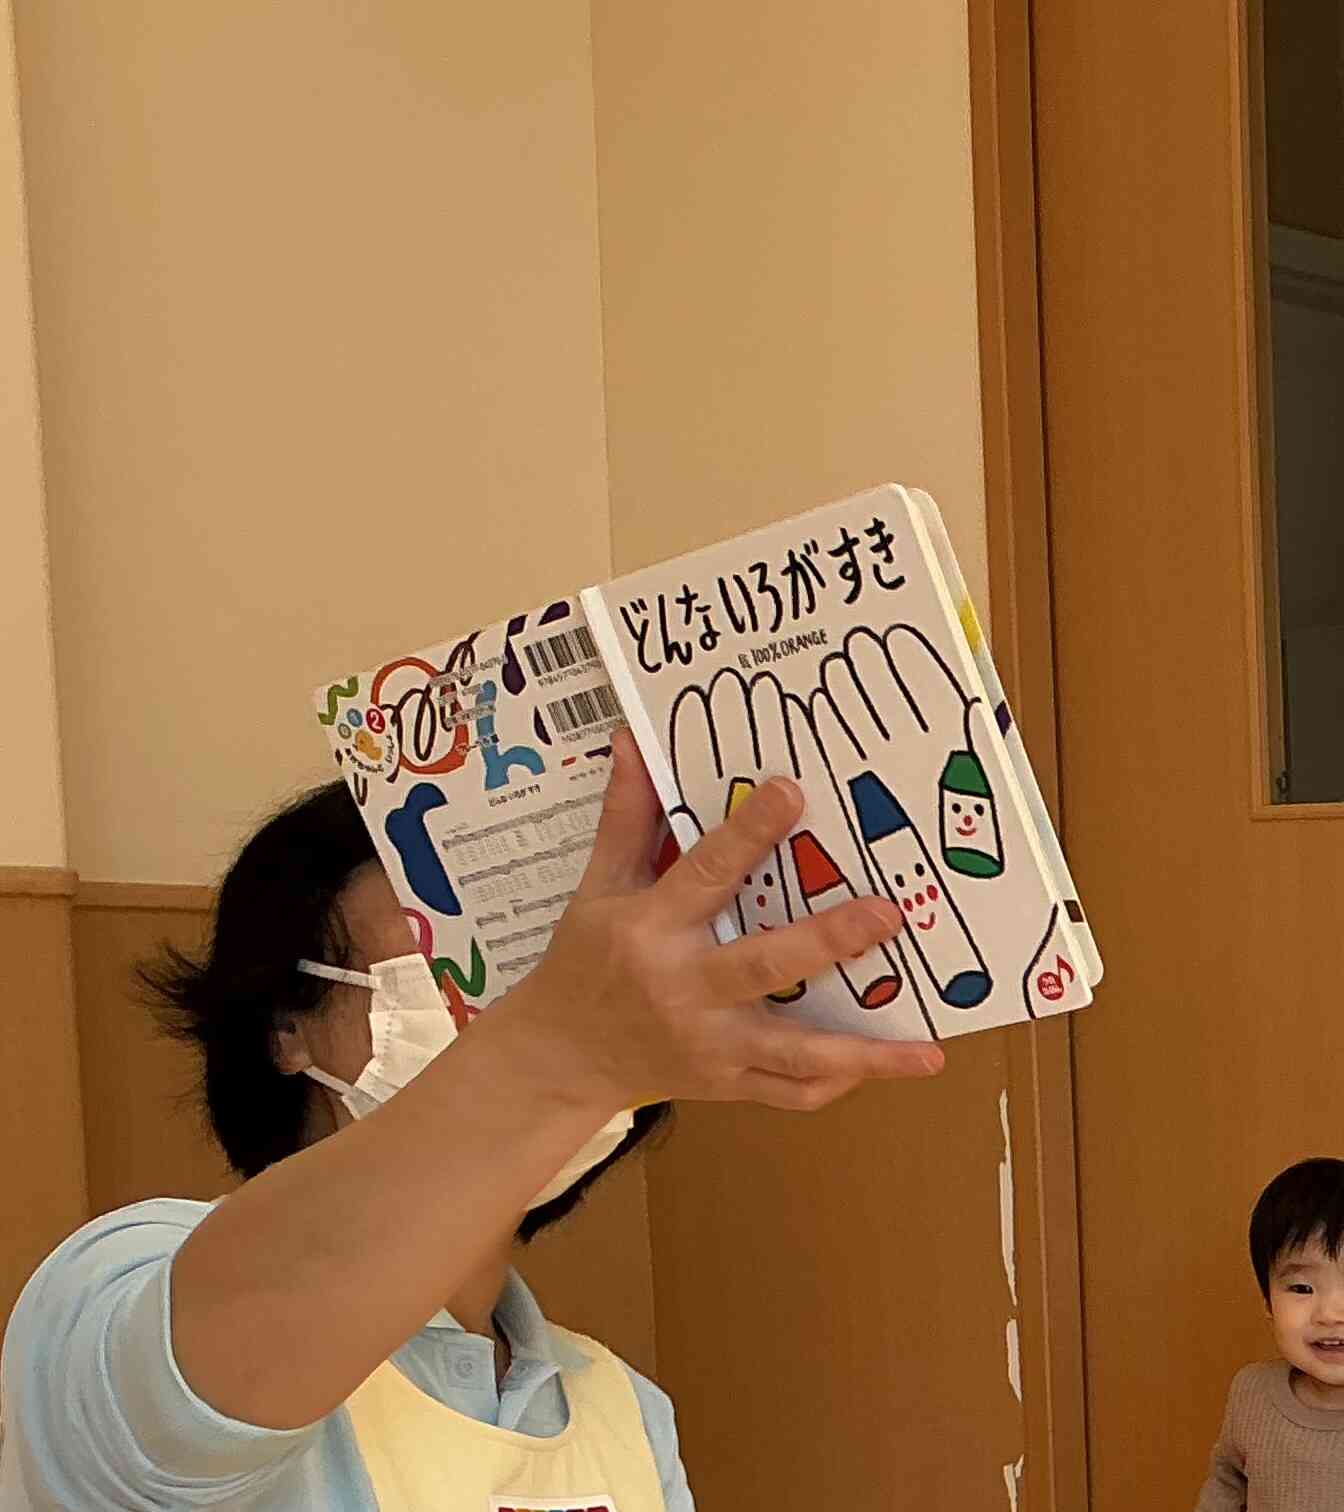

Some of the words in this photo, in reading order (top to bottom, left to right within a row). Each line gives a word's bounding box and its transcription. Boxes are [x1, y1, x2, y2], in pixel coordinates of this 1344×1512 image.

[619, 517, 906, 673] どんないろがすき
